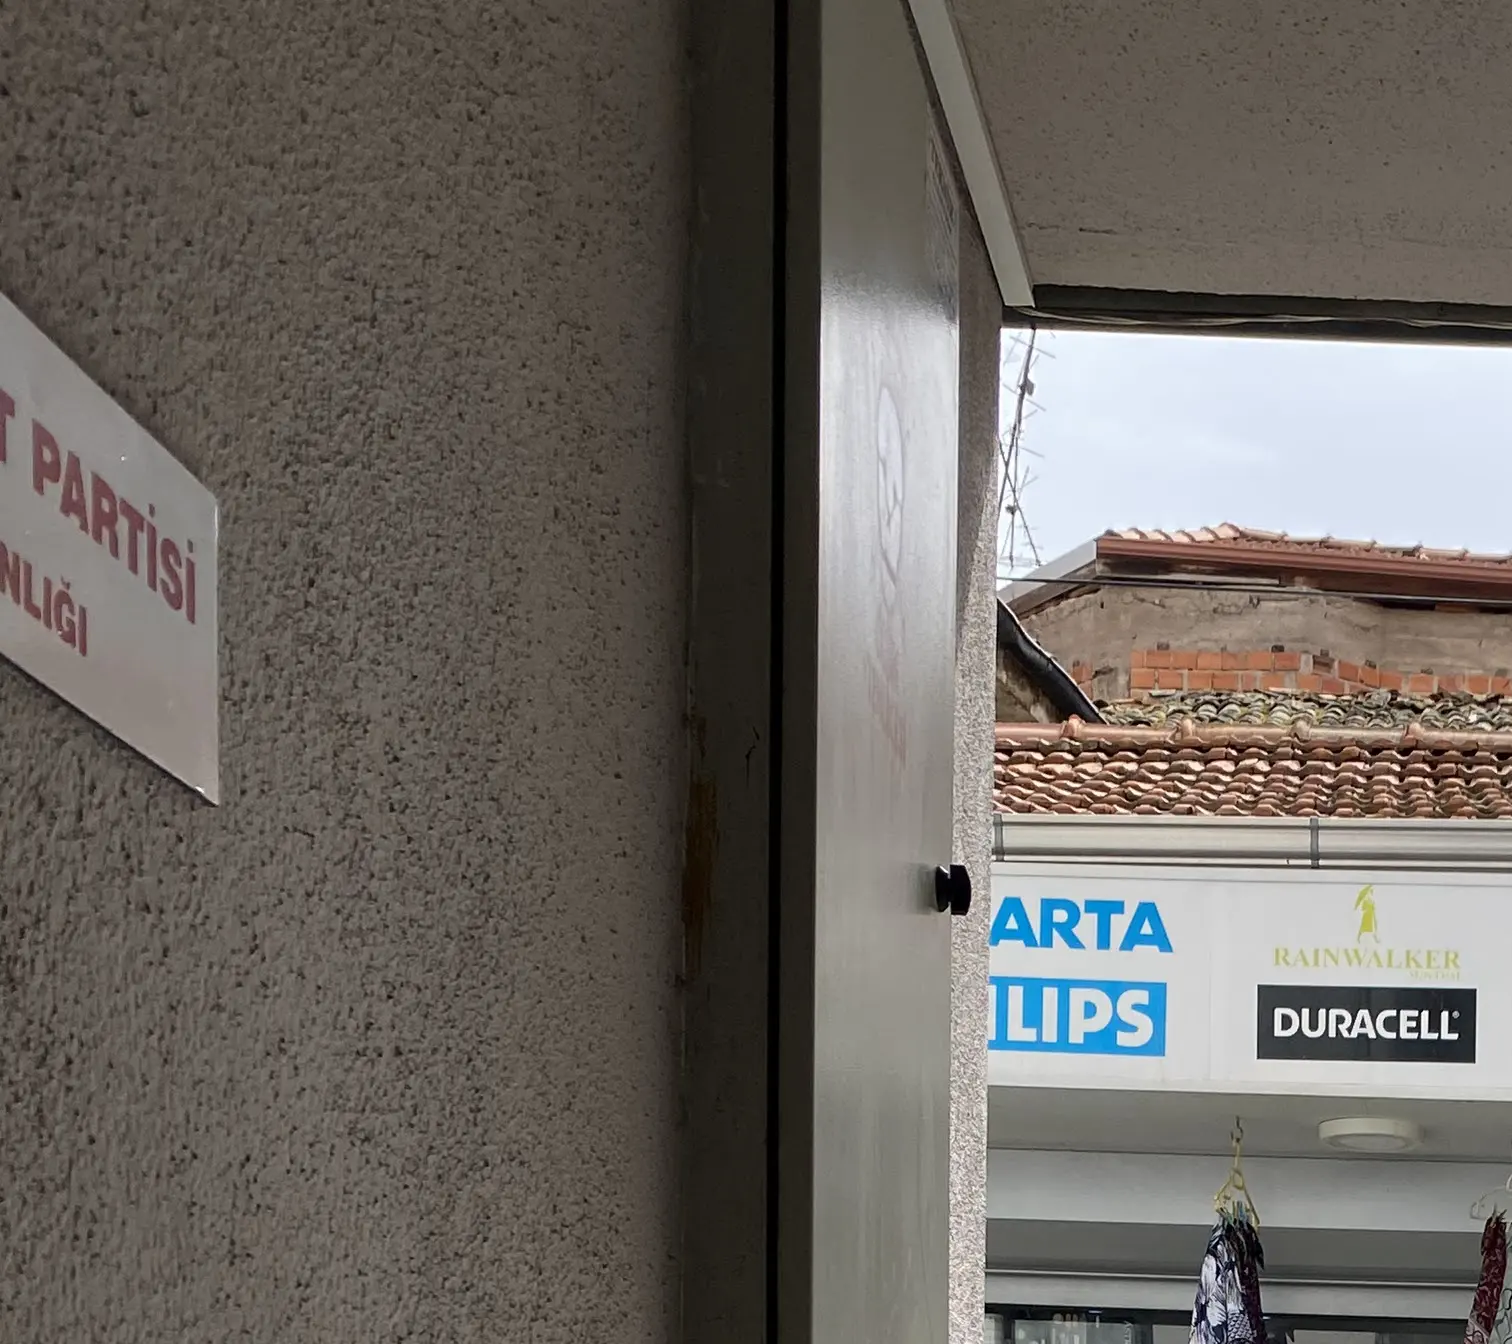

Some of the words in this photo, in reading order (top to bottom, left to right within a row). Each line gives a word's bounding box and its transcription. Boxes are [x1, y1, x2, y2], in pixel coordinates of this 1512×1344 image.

[31, 417, 196, 625] PARTİSİ
[0, 540, 88, 657] NLIĞI
[988, 895, 1174, 954] ARTA
[1272, 946, 1463, 971] RAINWALKER
[1273, 1006, 1460, 1041] DURACELL
